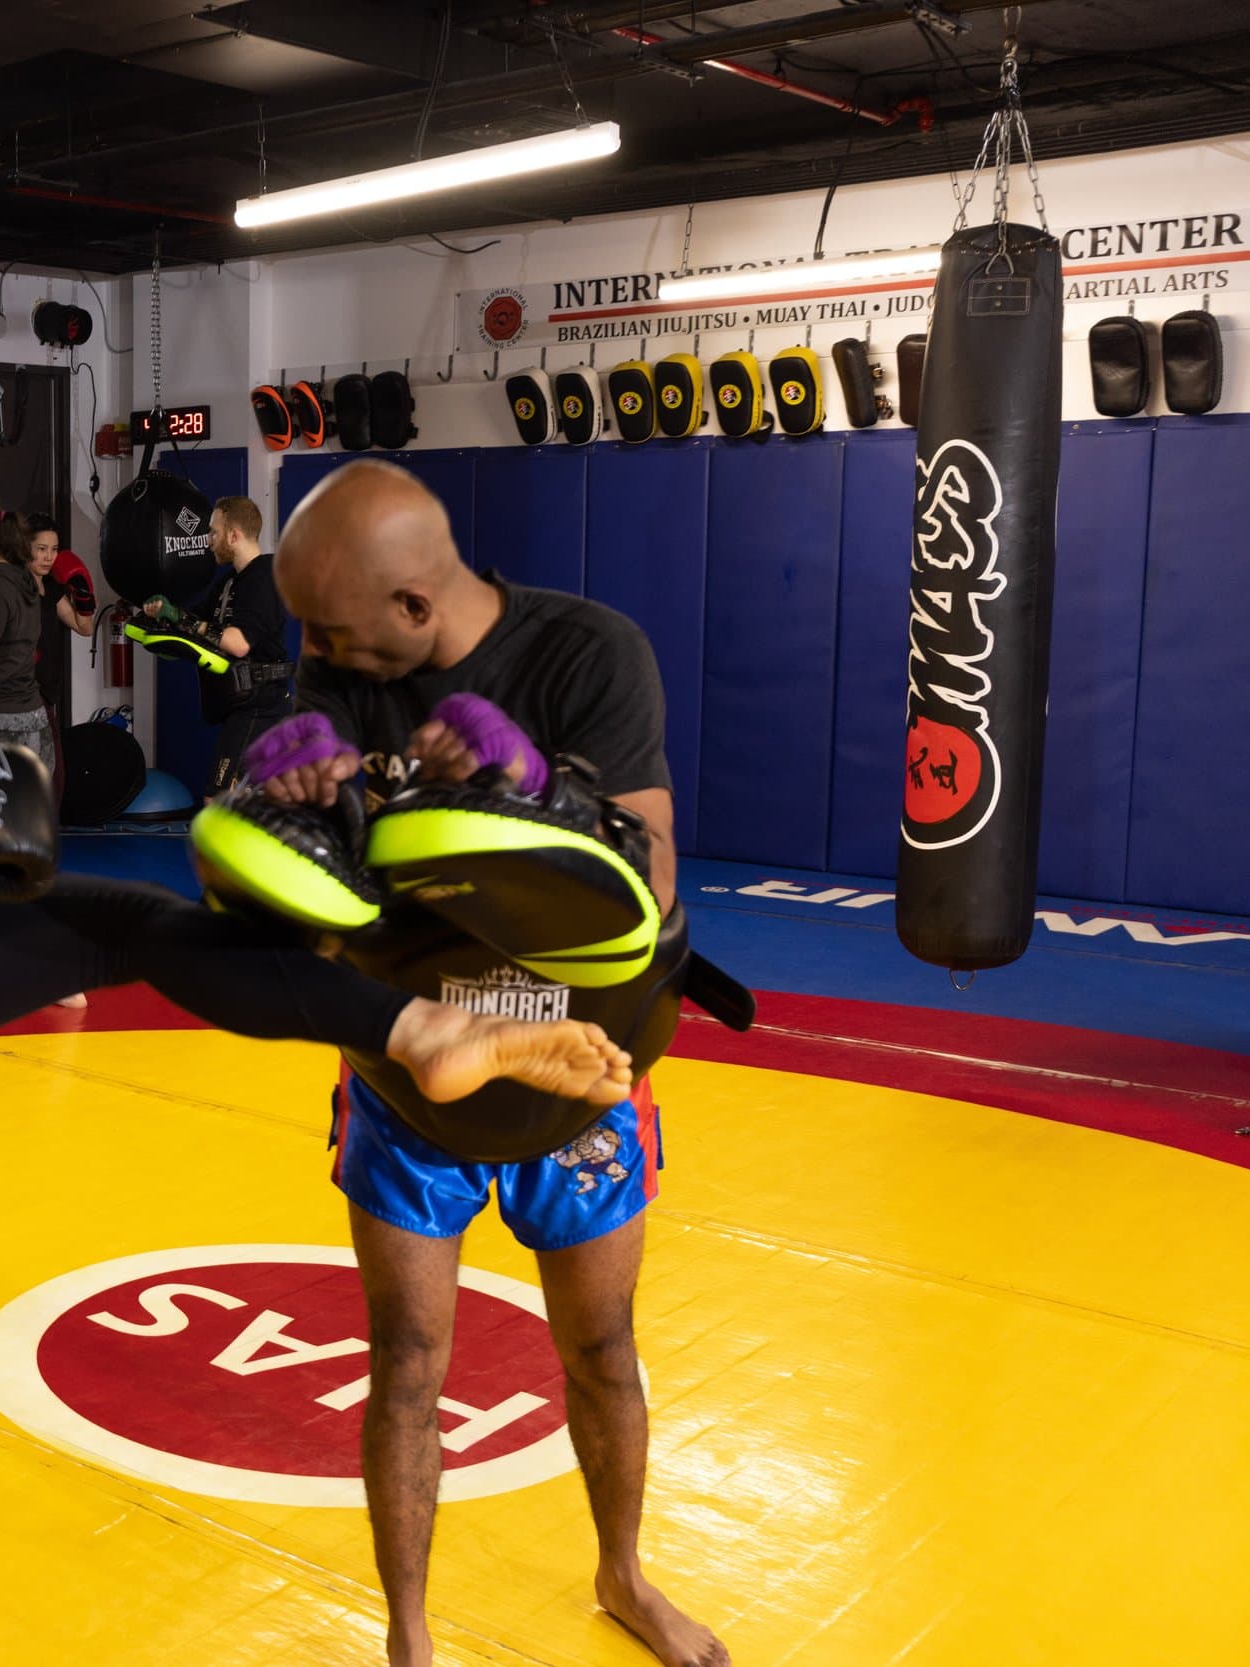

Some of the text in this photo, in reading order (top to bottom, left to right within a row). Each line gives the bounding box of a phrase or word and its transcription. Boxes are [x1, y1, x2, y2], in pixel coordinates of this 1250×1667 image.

[1061, 213, 1244, 260] CENTER
[558, 319, 651, 342] BRAZILIAN
[756, 305, 811, 325] MUAY
[817, 300, 867, 319] THAI
[1066, 277, 1156, 299] ARTIAL
[1162, 269, 1229, 293] ARTS
[170, 412, 203, 436] 2:28
[165, 534, 210, 554] KNOCKOU
[440, 980, 570, 1023] MONARCH
